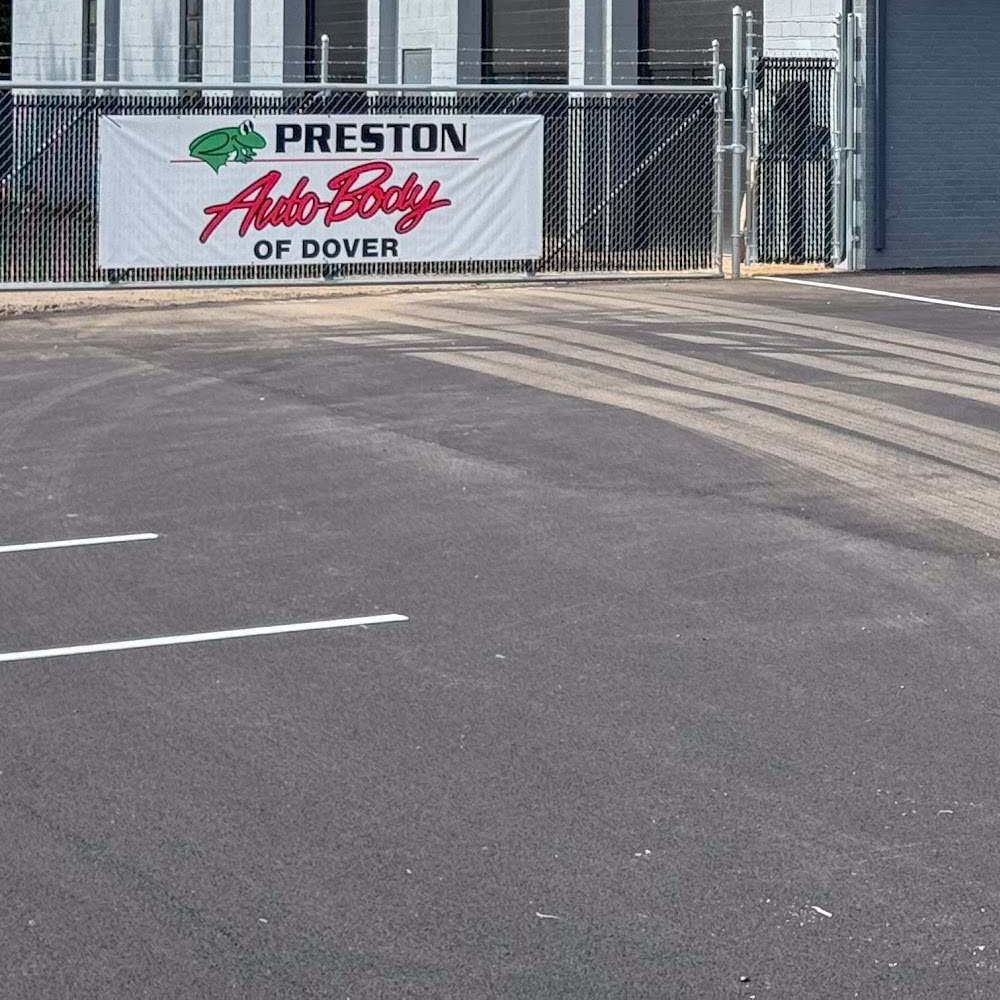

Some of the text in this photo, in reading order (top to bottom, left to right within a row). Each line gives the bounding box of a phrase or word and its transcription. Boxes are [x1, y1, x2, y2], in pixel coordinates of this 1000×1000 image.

[275, 123, 468, 154] PRESTON
[199, 161, 452, 245] Auto-Body
[253, 238, 399, 259] OF DOVER
